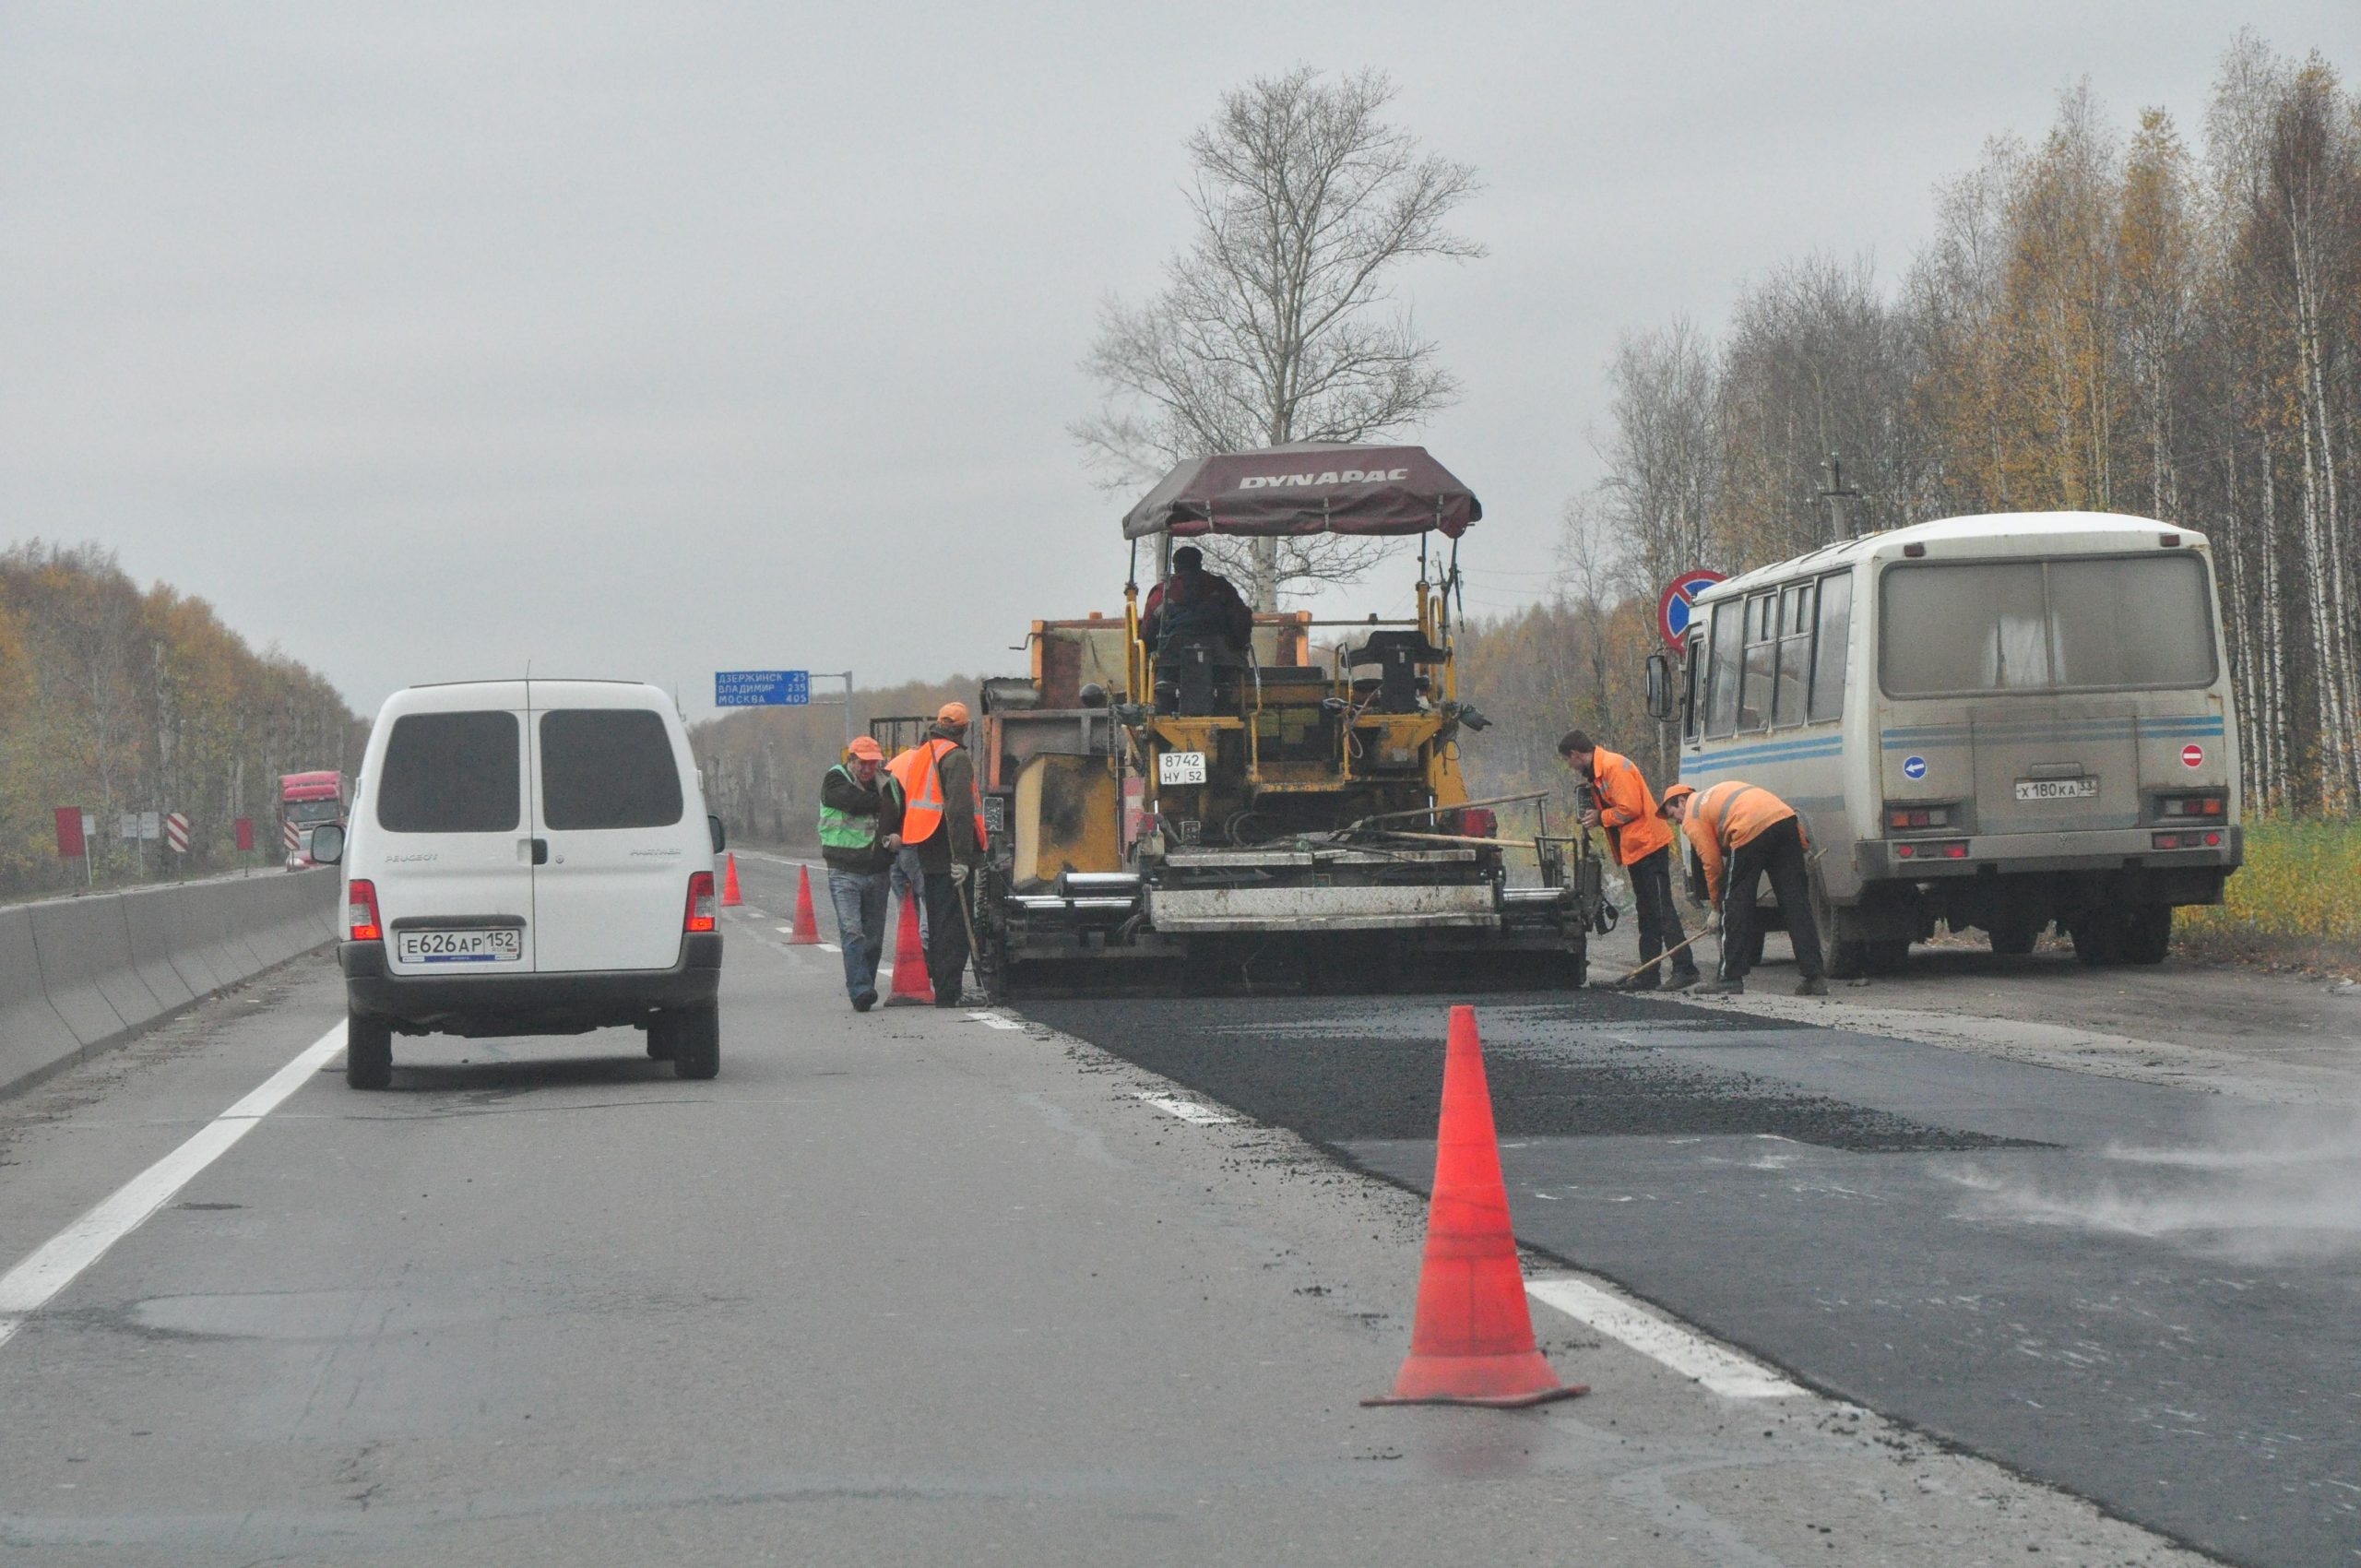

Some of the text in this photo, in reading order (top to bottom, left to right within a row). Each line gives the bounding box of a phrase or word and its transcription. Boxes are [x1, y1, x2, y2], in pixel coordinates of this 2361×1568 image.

[1240, 469, 1407, 489] DYNAPAC
[718, 672, 806, 683] ДЗЕРЖИНСК 25
[718, 683, 806, 694] ВЛАДИМИР 235
[718, 694, 807, 704] МОСКВА 405
[1165, 754, 1200, 767] 8742
[1189, 770, 1203, 781] 52
[486, 932, 514, 947] 152
